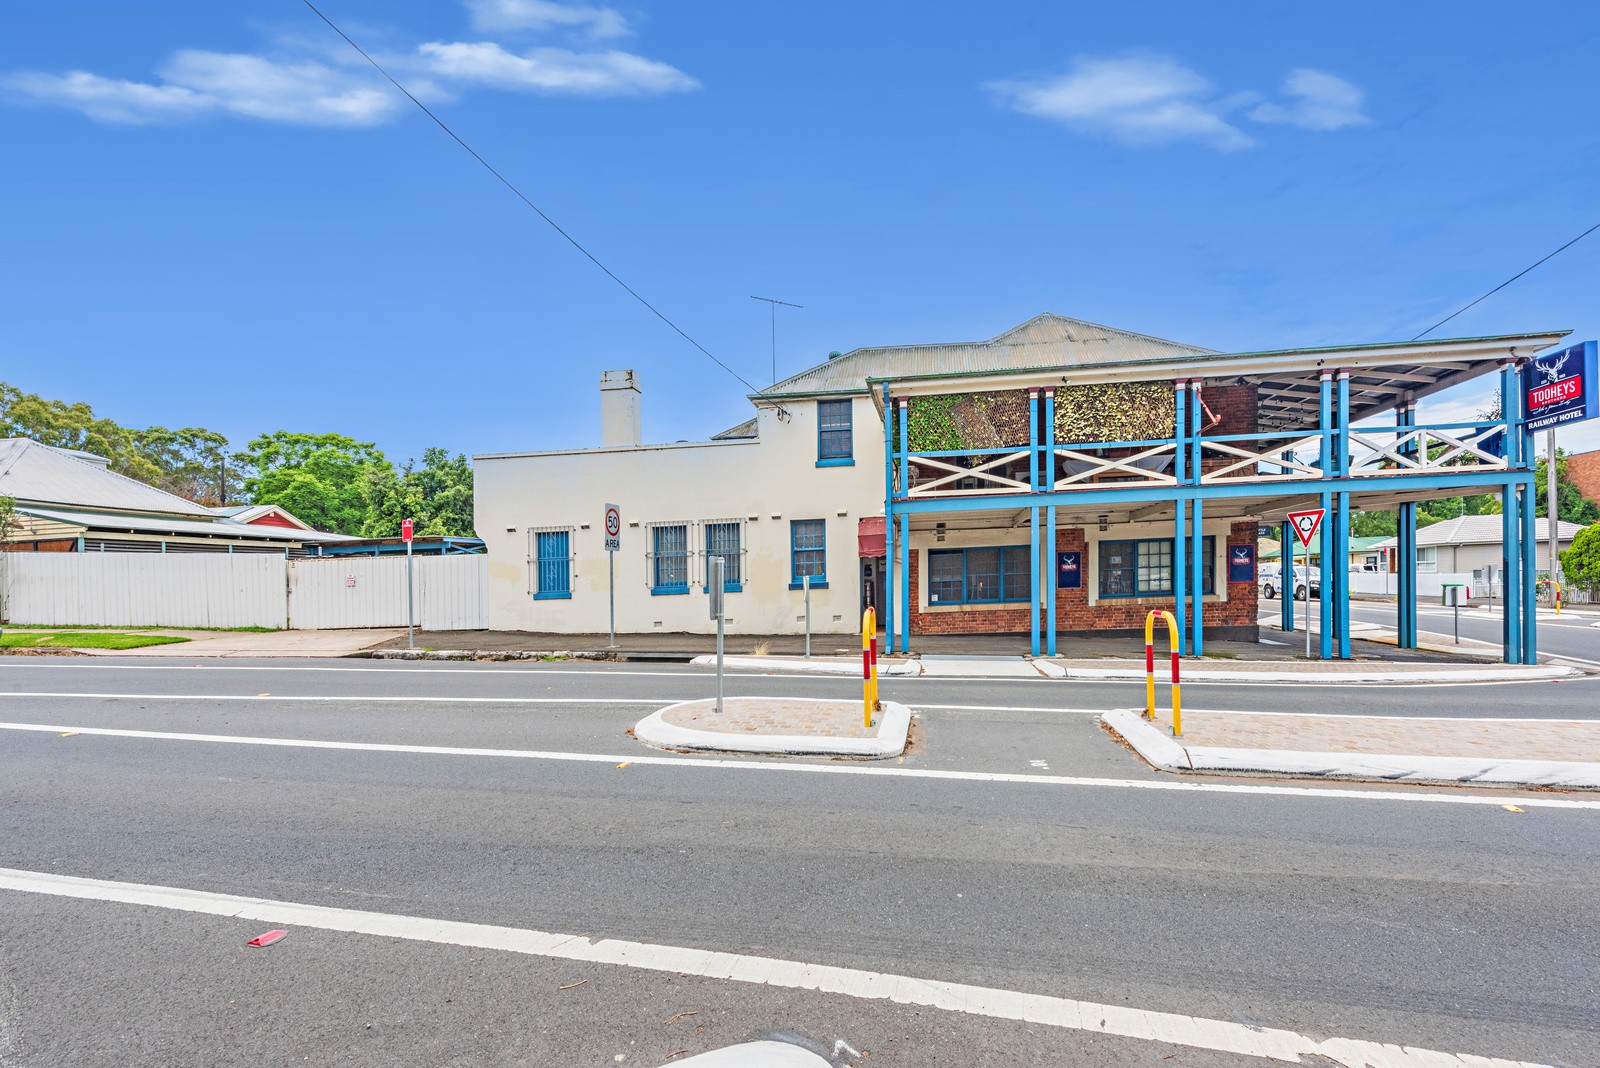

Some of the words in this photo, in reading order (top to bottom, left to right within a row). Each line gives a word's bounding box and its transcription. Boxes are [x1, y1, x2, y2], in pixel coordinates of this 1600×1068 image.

[1533, 381, 1576, 403] TOOHEYS
[1528, 416, 1558, 430] RAILWAY
[1559, 410, 1583, 421] HOTEL
[608, 515, 618, 529] 50
[605, 538, 620, 548] AREA
